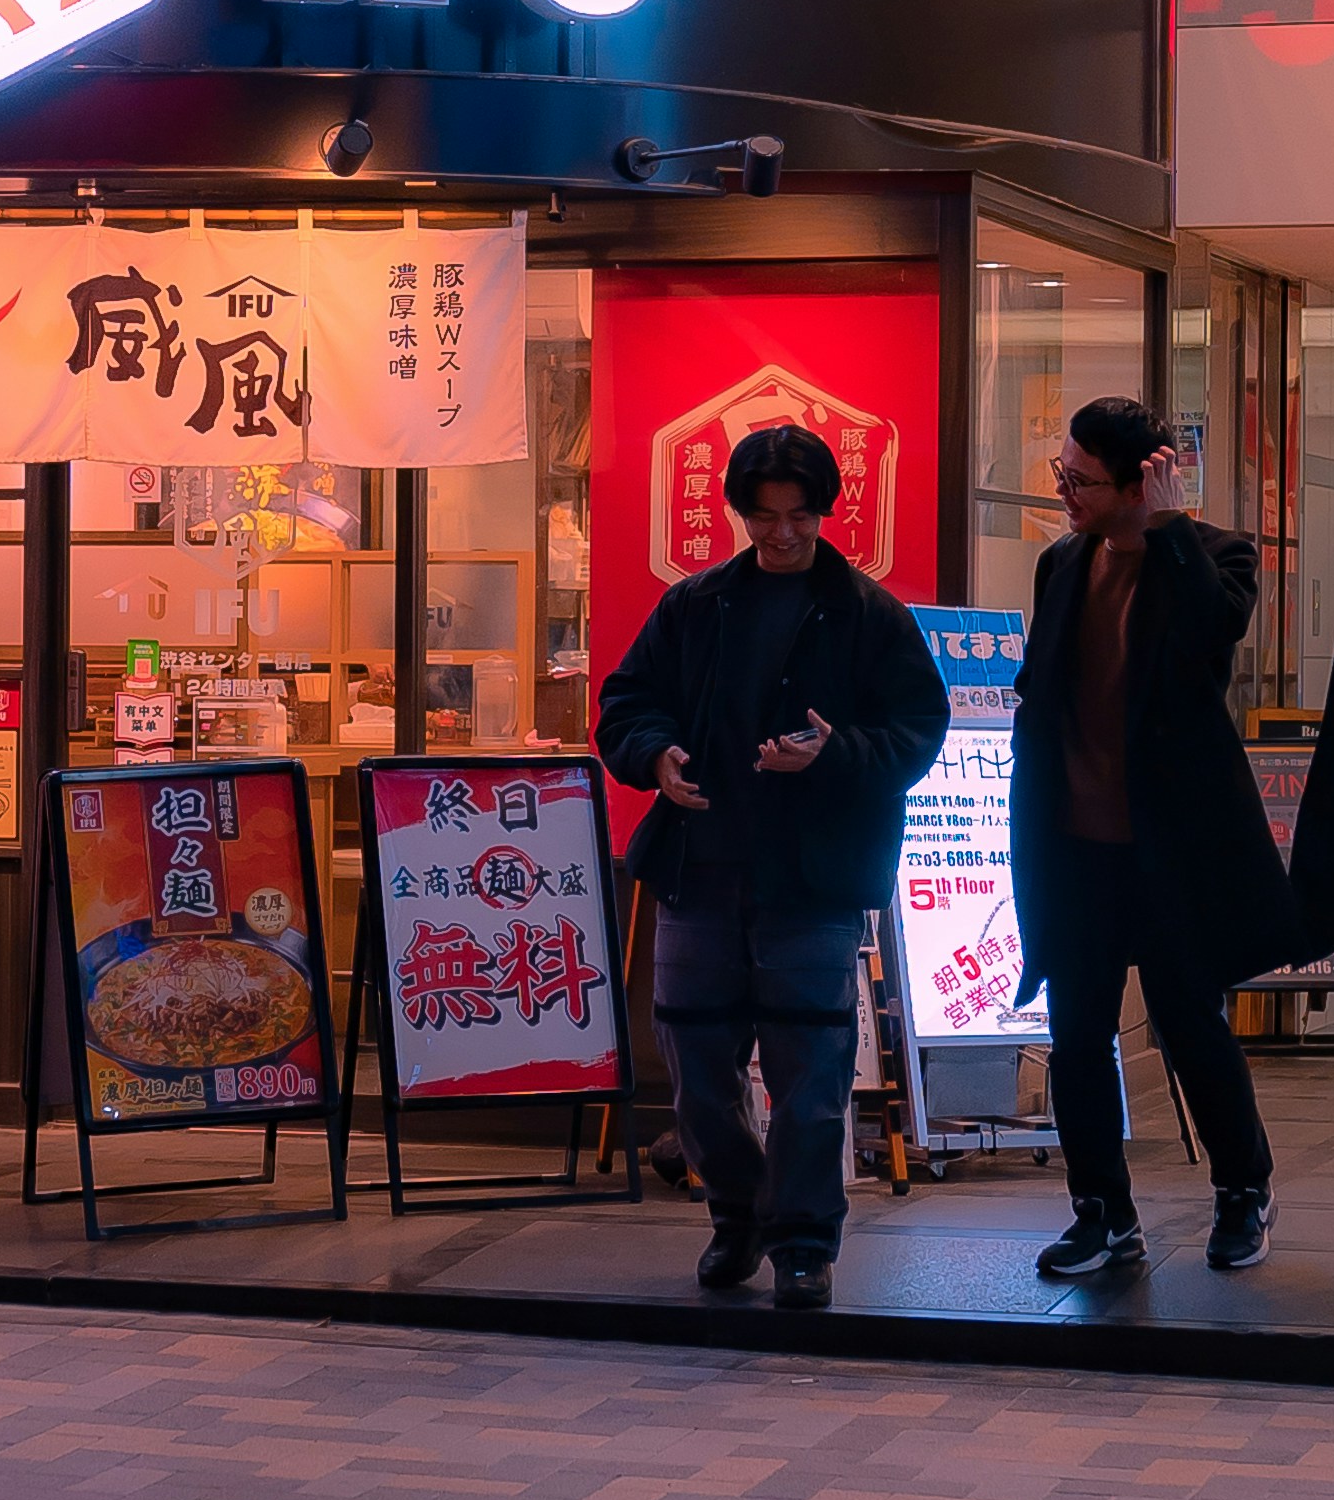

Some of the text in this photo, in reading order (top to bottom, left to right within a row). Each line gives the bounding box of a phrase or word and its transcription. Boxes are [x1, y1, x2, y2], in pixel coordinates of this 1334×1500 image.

[226, 291, 275, 319] IFU
[386, 262, 419, 382] 濃厚味噌
[432, 261, 466, 430] 豚鶏Wスープ
[682, 441, 713, 563] 濃厚味噌
[194, 588, 281, 636] IFU
[160, 650, 313, 671] 渋谷センター街店
[124, 704, 164, 718] 有中文
[423, 778, 543, 835] 終日
[152, 787, 217, 917] 担々麺
[251, 894, 286, 912] 濃厚
[954, 876, 995, 896] Floor
[394, 913, 607, 1034] 無料
[238, 1064, 317, 1100] 890円
